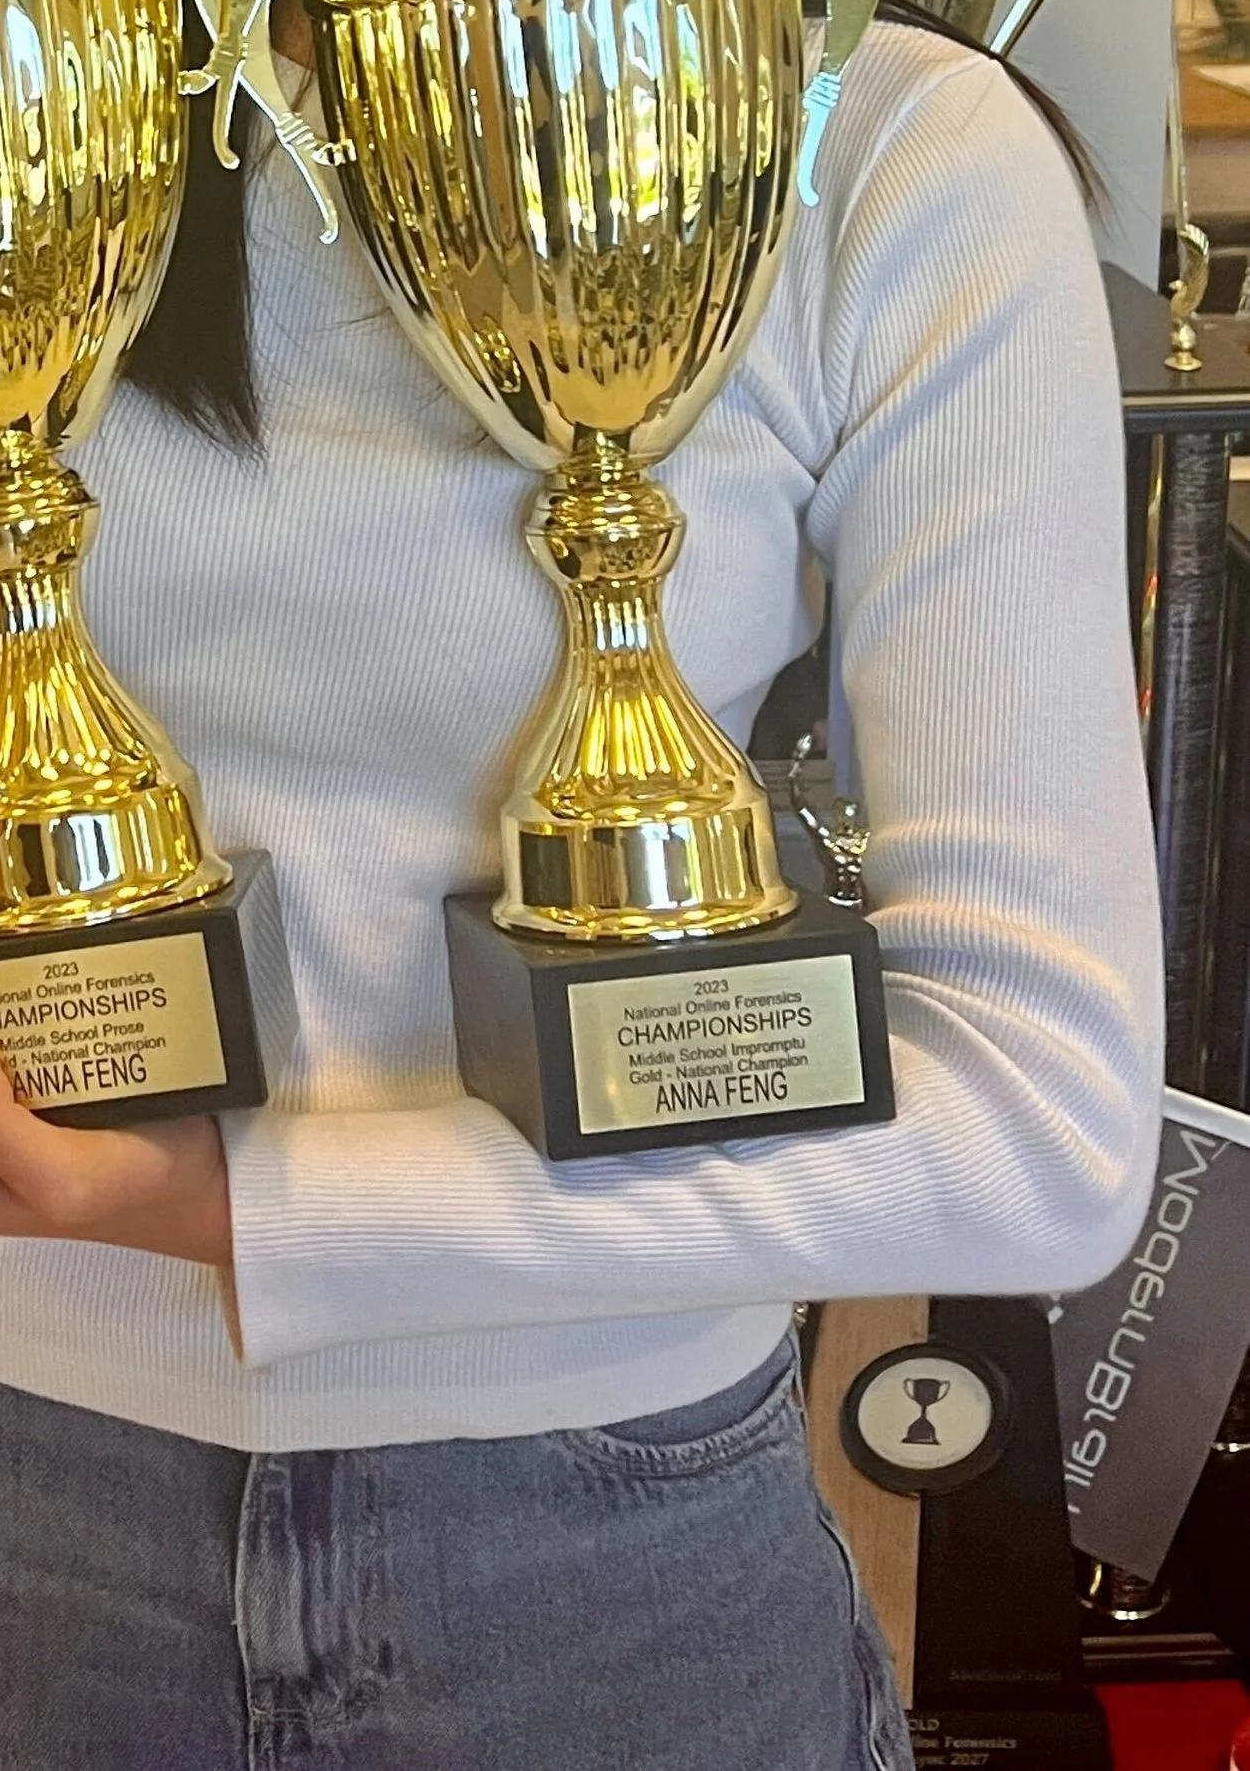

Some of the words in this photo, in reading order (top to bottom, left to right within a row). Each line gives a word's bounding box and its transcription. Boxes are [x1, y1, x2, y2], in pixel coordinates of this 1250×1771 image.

[36, 979, 82, 997] Online
[86, 971, 155, 992] Forensics
[43, 962, 79, 979] 2023
[694, 979, 729, 996] 2023
[624, 1001, 682, 1022] National
[685, 999, 731, 1015] Online
[735, 990, 802, 1009] Forensics
[0, 1035, 46, 1052] Middle
[50, 1026, 99, 1045] School
[102, 1020, 144, 1038] Prose
[617, 1007, 813, 1047] CHAMPIONSHIPS
[31, 1044, 90, 1065] National
[93, 1035, 166, 1058] Champion
[628, 1051, 676, 1068] Middle
[679, 1044, 728, 1063] School
[731, 1036, 806, 1058] Impromptu
[13, 1063, 78, 1100] ANNA
[82, 1054, 147, 1091] FENG
[629, 1070, 663, 1085] Gold
[675, 1063, 734, 1080] National
[737, 1054, 809, 1073] Champion
[656, 1079, 721, 1114] ANNA
[725, 1071, 788, 1106] FENG
